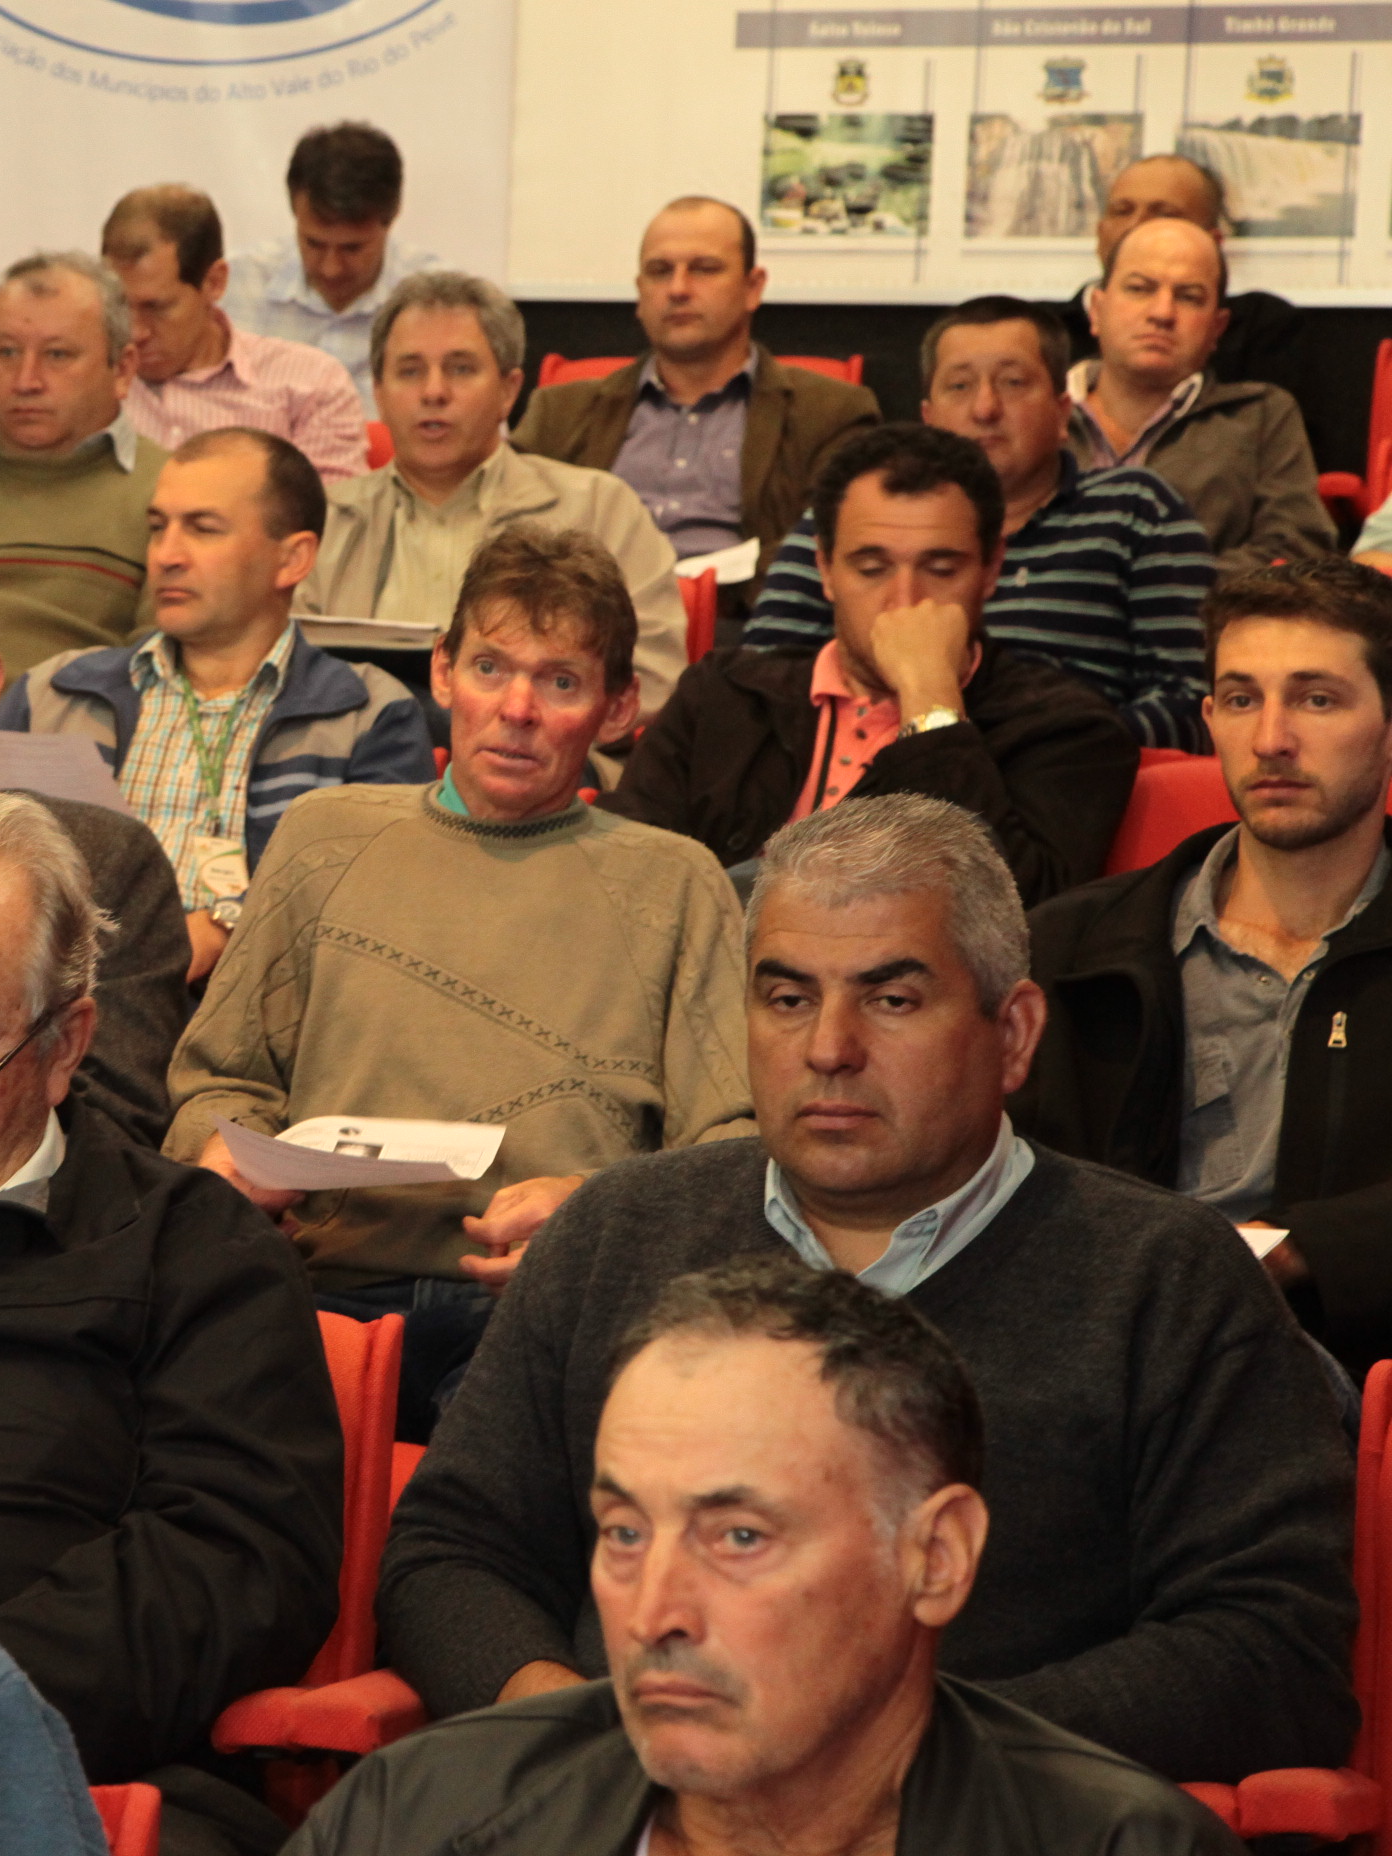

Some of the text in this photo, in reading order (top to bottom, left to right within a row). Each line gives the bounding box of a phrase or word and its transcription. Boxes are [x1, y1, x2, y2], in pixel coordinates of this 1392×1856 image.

[226, 82, 267, 100] Alto
[270, 77, 313, 97] Vale
[316, 69, 344, 90] do
[346, 57, 380, 79] Rio
